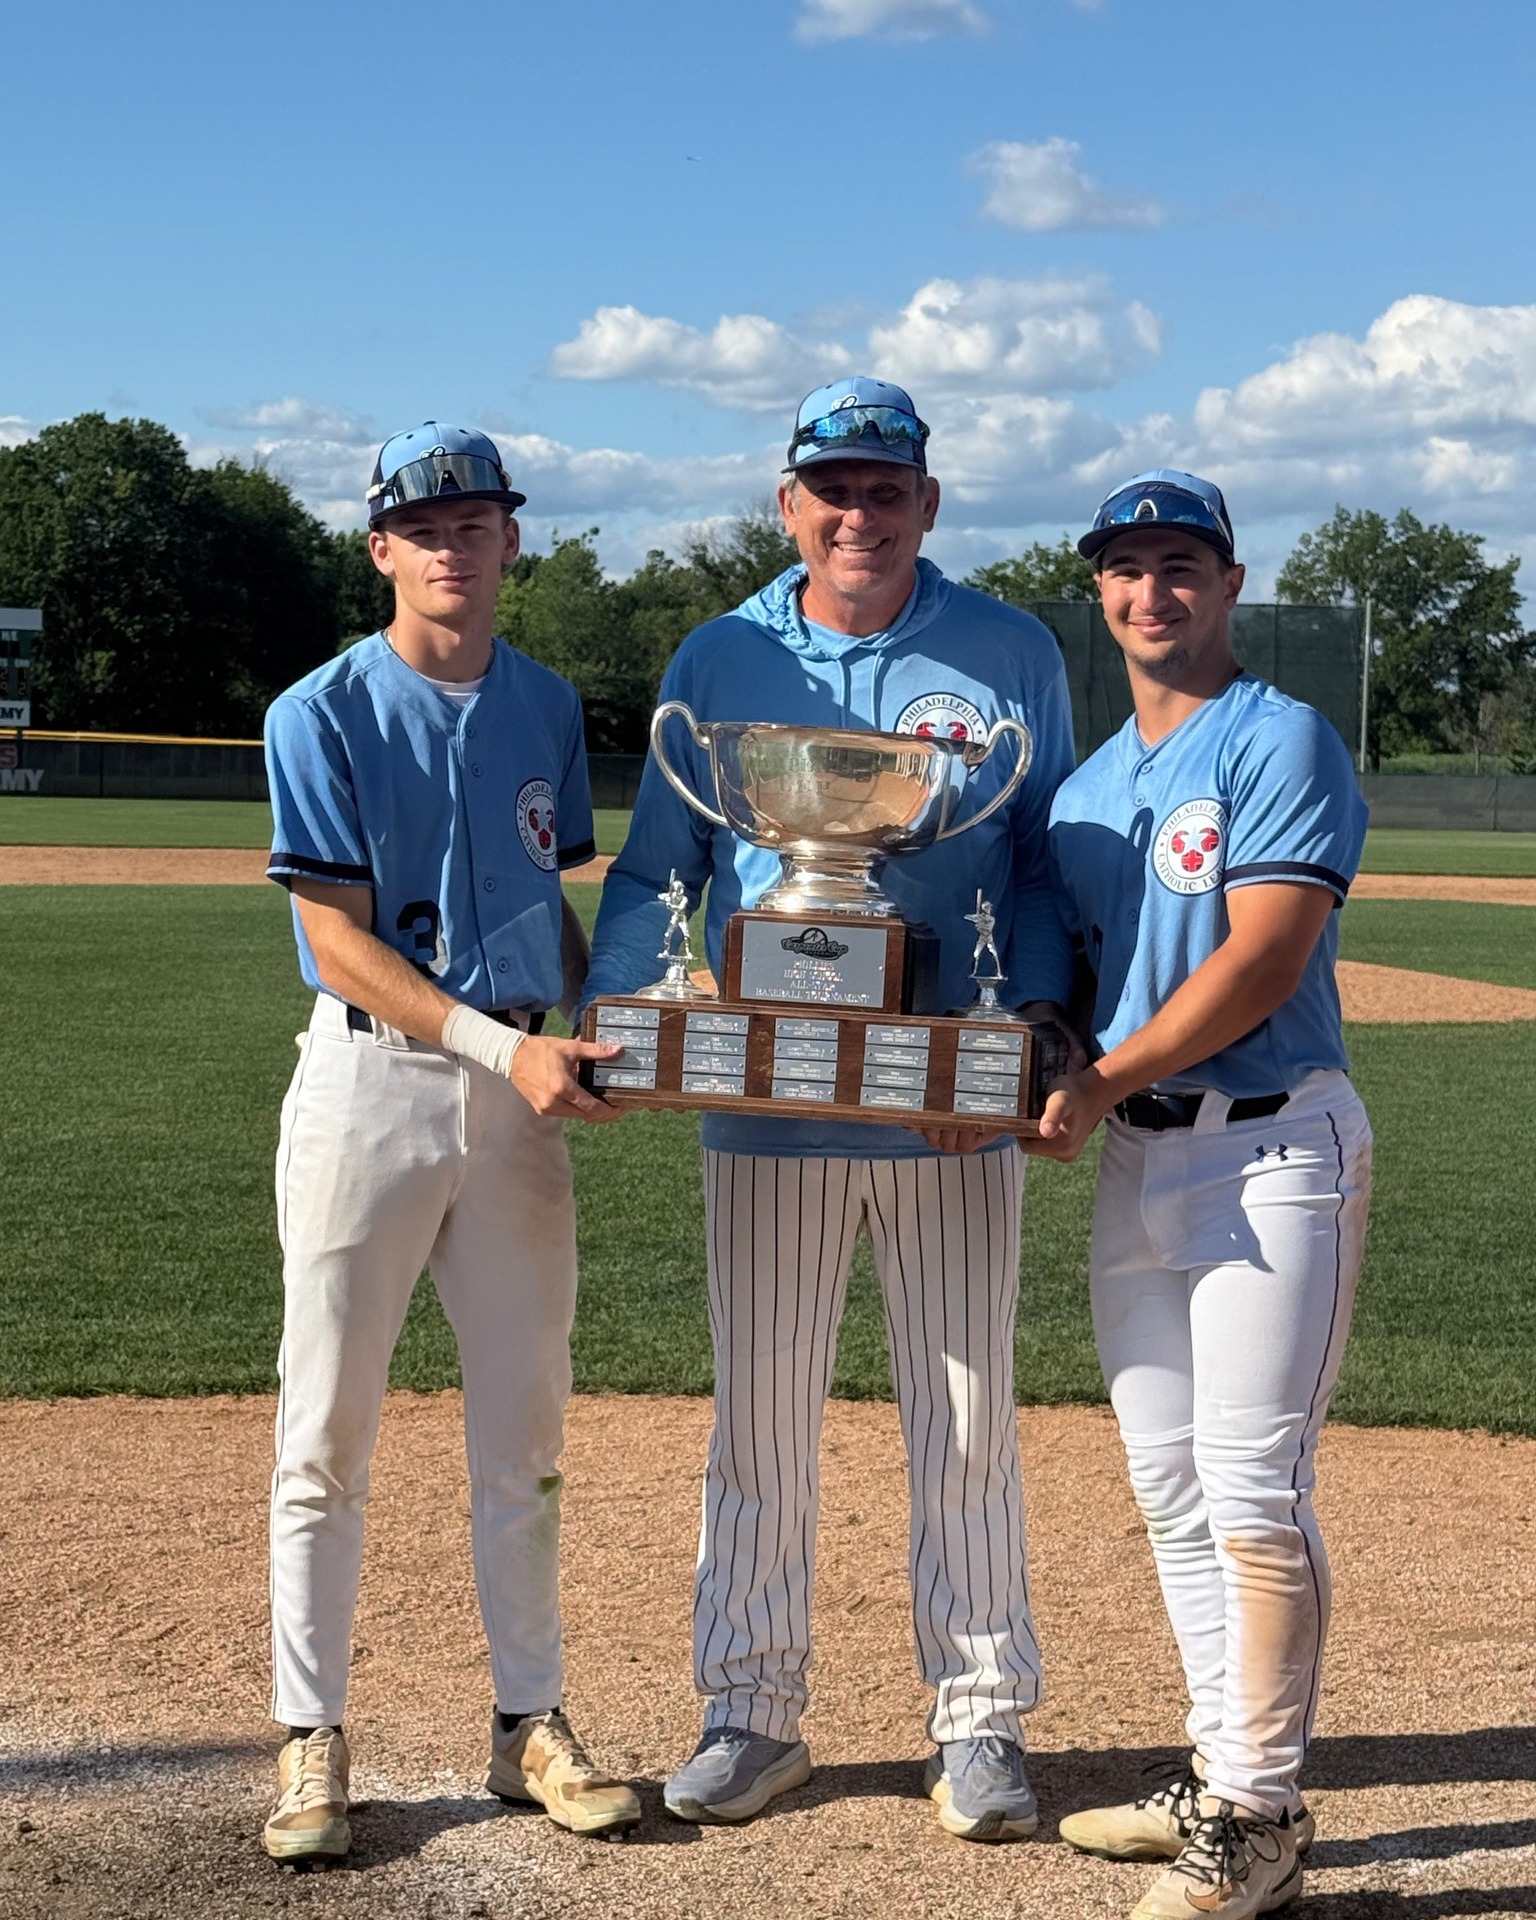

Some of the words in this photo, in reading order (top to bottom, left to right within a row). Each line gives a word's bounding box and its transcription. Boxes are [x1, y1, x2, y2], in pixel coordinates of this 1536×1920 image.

[902, 697, 980, 727] PHILADELPHIA
[520, 827, 550, 868] CATHOLIC
[1157, 853, 1197, 892] CATHOLIC
[396, 900, 447, 979] 3
[783, 969, 807, 979] HIGH
[810, 970, 844, 982] SCHOOL
[790, 980, 836, 992] ALL-STAR
[755, 987, 803, 999] BASEBALL
[805, 990, 870, 1003] TOURNAMENT
